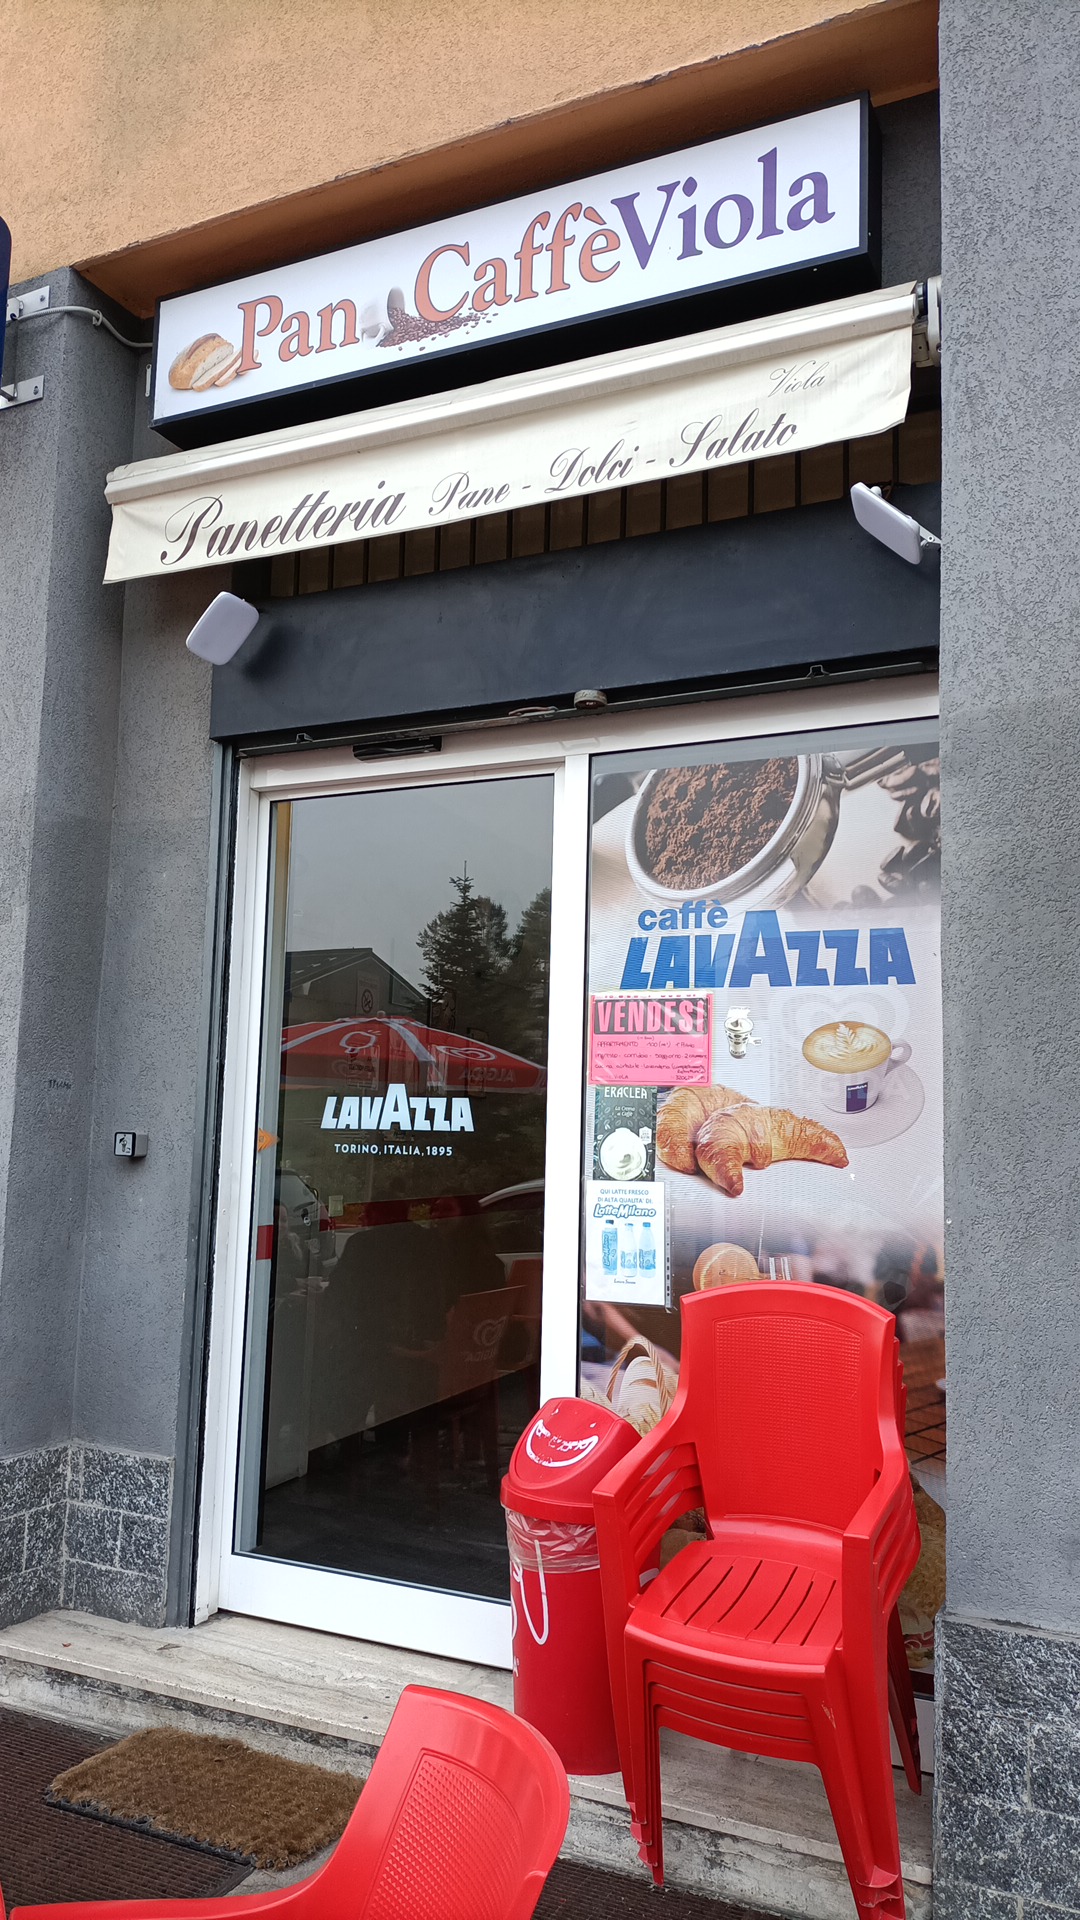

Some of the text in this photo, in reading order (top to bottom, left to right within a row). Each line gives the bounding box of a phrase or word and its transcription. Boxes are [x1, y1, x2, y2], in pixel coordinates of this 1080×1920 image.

[237, 146, 836, 374] Pan Caffè Viola
[767, 360, 827, 398] Viola
[160, 481, 405, 564] Panetteria
[428, 472, 511, 517] Pane
[545, 438, 638, 497] Dolci
[669, 407, 799, 467] Salato
[637, 899, 728, 931] caffè
[618, 909, 917, 989] LAVAZZA
[597, 1000, 705, 1032] VENDESI
[320, 1083, 475, 1132] LAVAZZA
[604, 1086, 648, 1099] ERACLEA
[426, 1145, 453, 1157] 1895
[593, 1203, 657, 1219] LatteMilano
